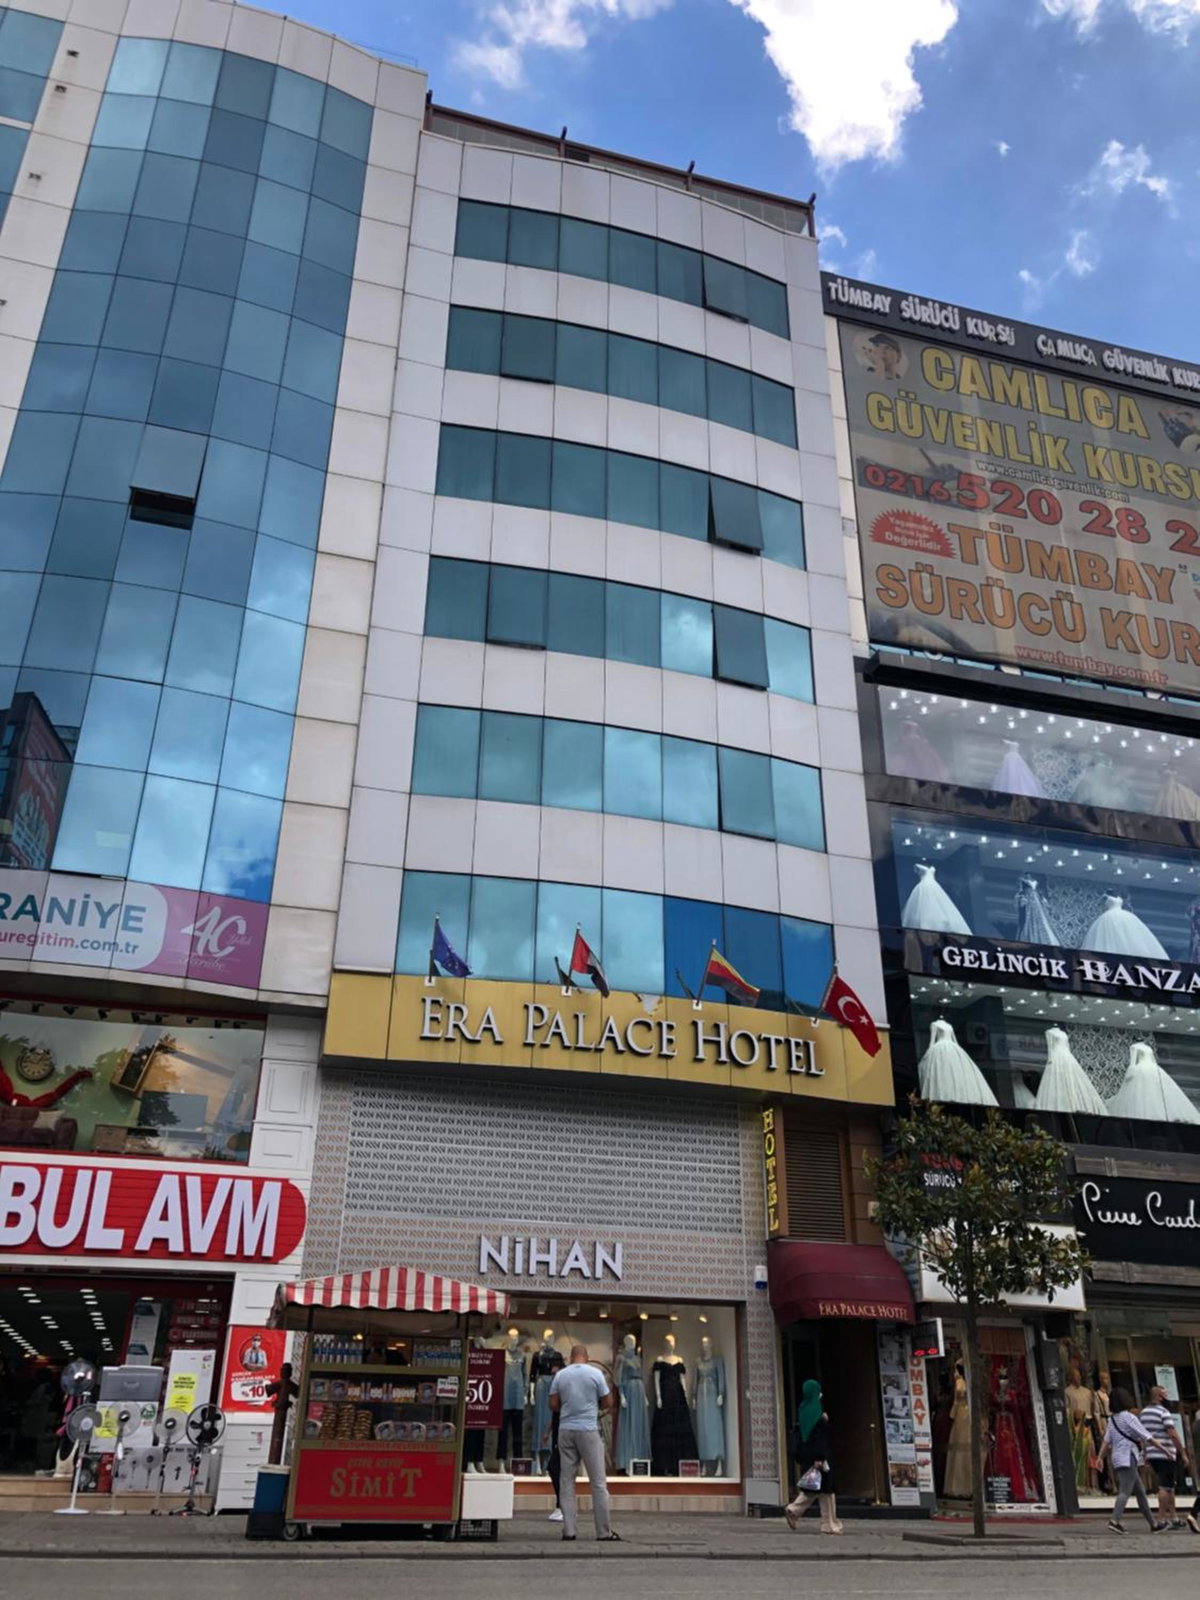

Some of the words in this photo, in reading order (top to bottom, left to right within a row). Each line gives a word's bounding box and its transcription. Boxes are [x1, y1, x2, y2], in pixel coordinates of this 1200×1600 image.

[828, 278, 892, 313] TÜMBAY
[900, 296, 960, 331] SÜRÜCÜ
[1102, 348, 1170, 382] GÜVENLİK
[865, 390, 1074, 474] GÜVENLİK
[864, 463, 951, 502] 0216
[957, 472, 1063, 526] 520
[1079, 499, 1151, 544] 28
[875, 562, 1087, 643] SÜRÜCÜ
[947, 521, 1176, 604] TÜMBAY
[942, 945, 1068, 979] GELİNCİK
[419, 996, 504, 1045] ERA
[523, 1003, 678, 1057] PALACE
[694, 1019, 826, 1077] HOTEL
[762, 1107, 779, 1232] HOTEL
[0, 1165, 125, 1250] BUL
[134, 1173, 282, 1258] AVM
[840, 1302, 877, 1317] PALACE
[465, 1379, 493, 1404] 50
